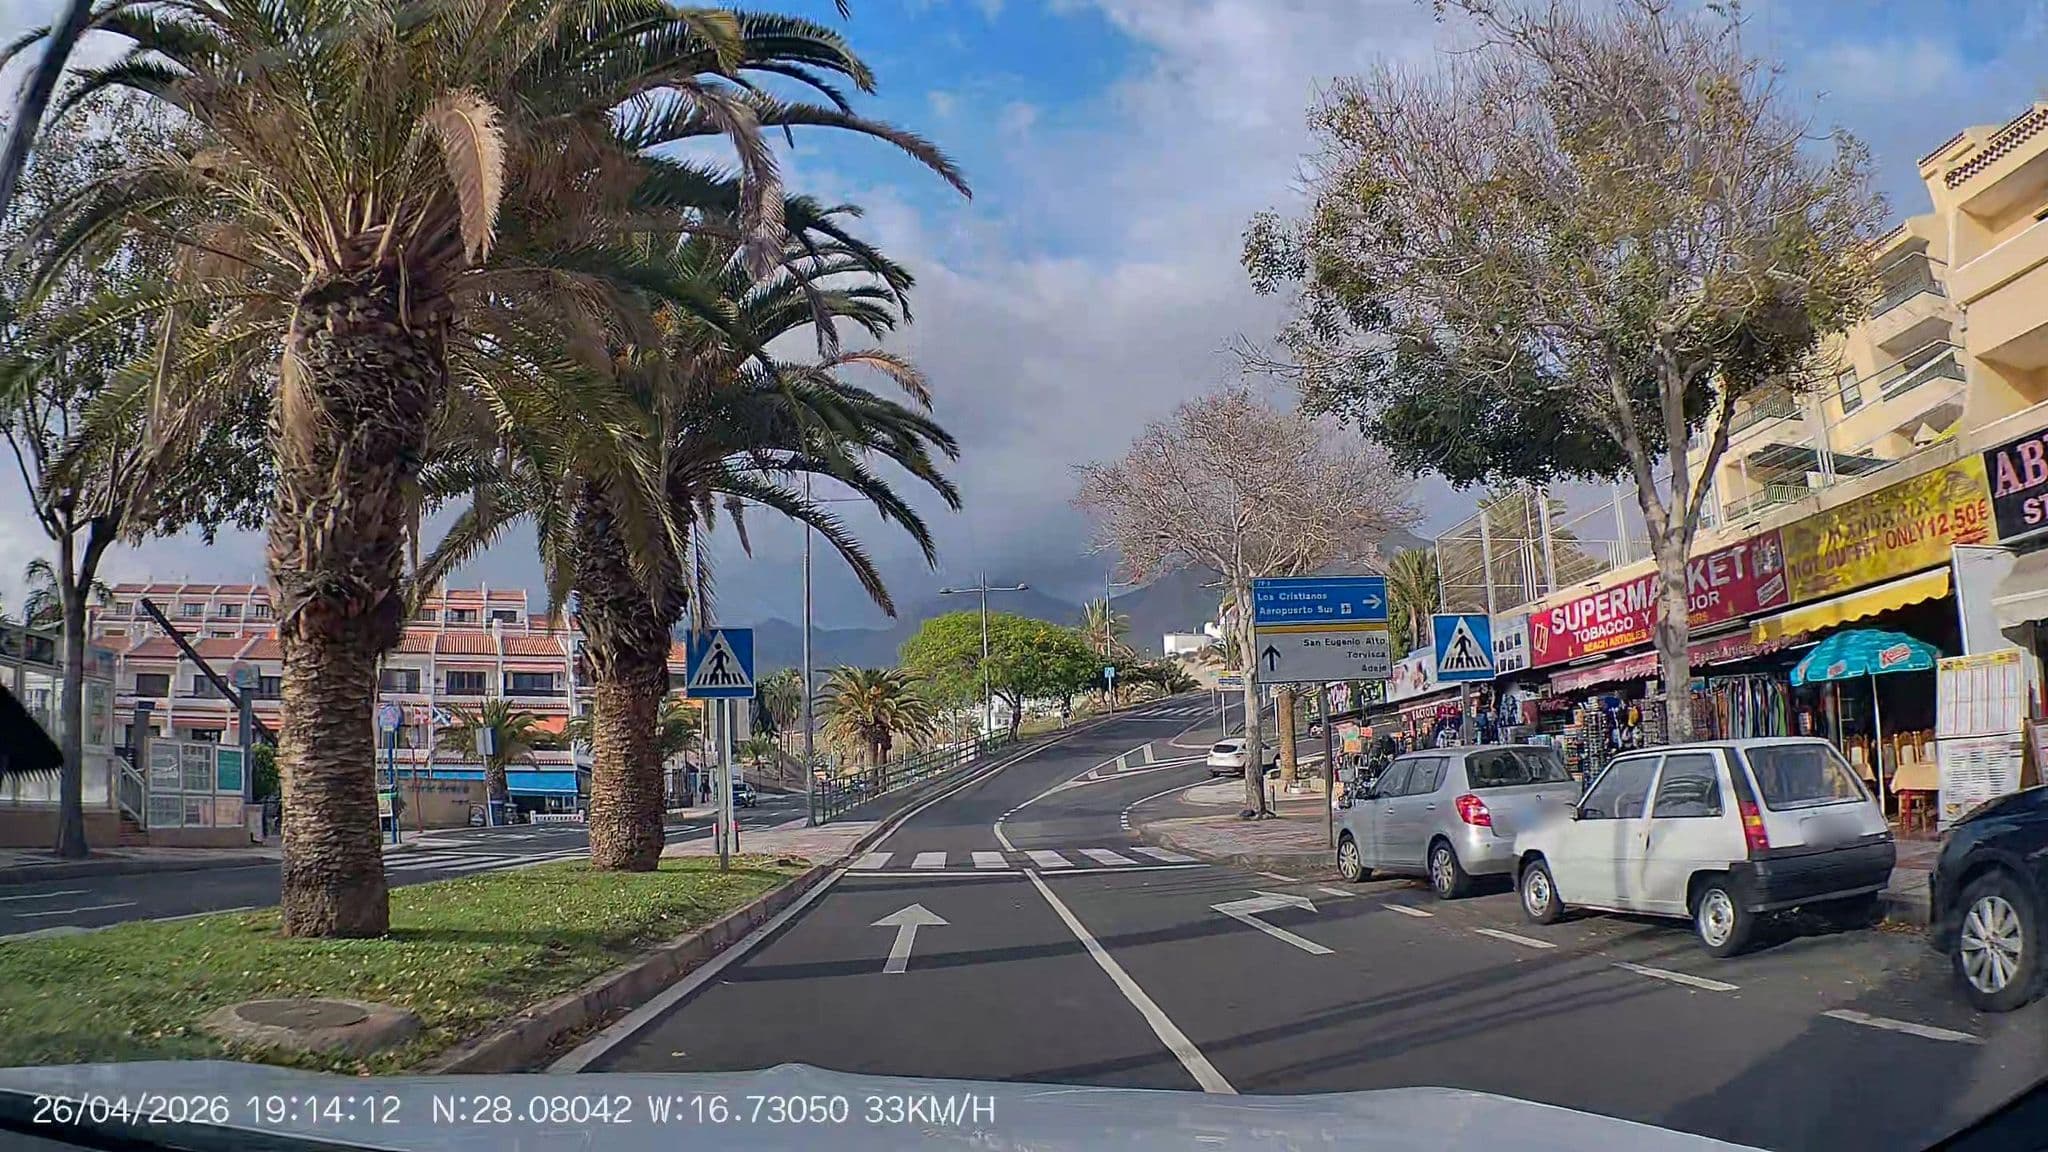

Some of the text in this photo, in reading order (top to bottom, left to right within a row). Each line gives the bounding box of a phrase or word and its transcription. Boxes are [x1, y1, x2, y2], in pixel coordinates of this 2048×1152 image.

[1885, 519, 1925, 549] ONLY
[1551, 545, 1747, 635] SUPERMAKET
[1257, 591, 1328, 601] Los Cristianos
[1259, 605, 1334, 616] Aeropuerto Sur
[1573, 616, 1634, 644] TOBACCO
[1303, 635, 1386, 647] San Eugenio Alto
[1347, 650, 1386, 659] Torvisca
[1361, 663, 1387, 673] Adeje
